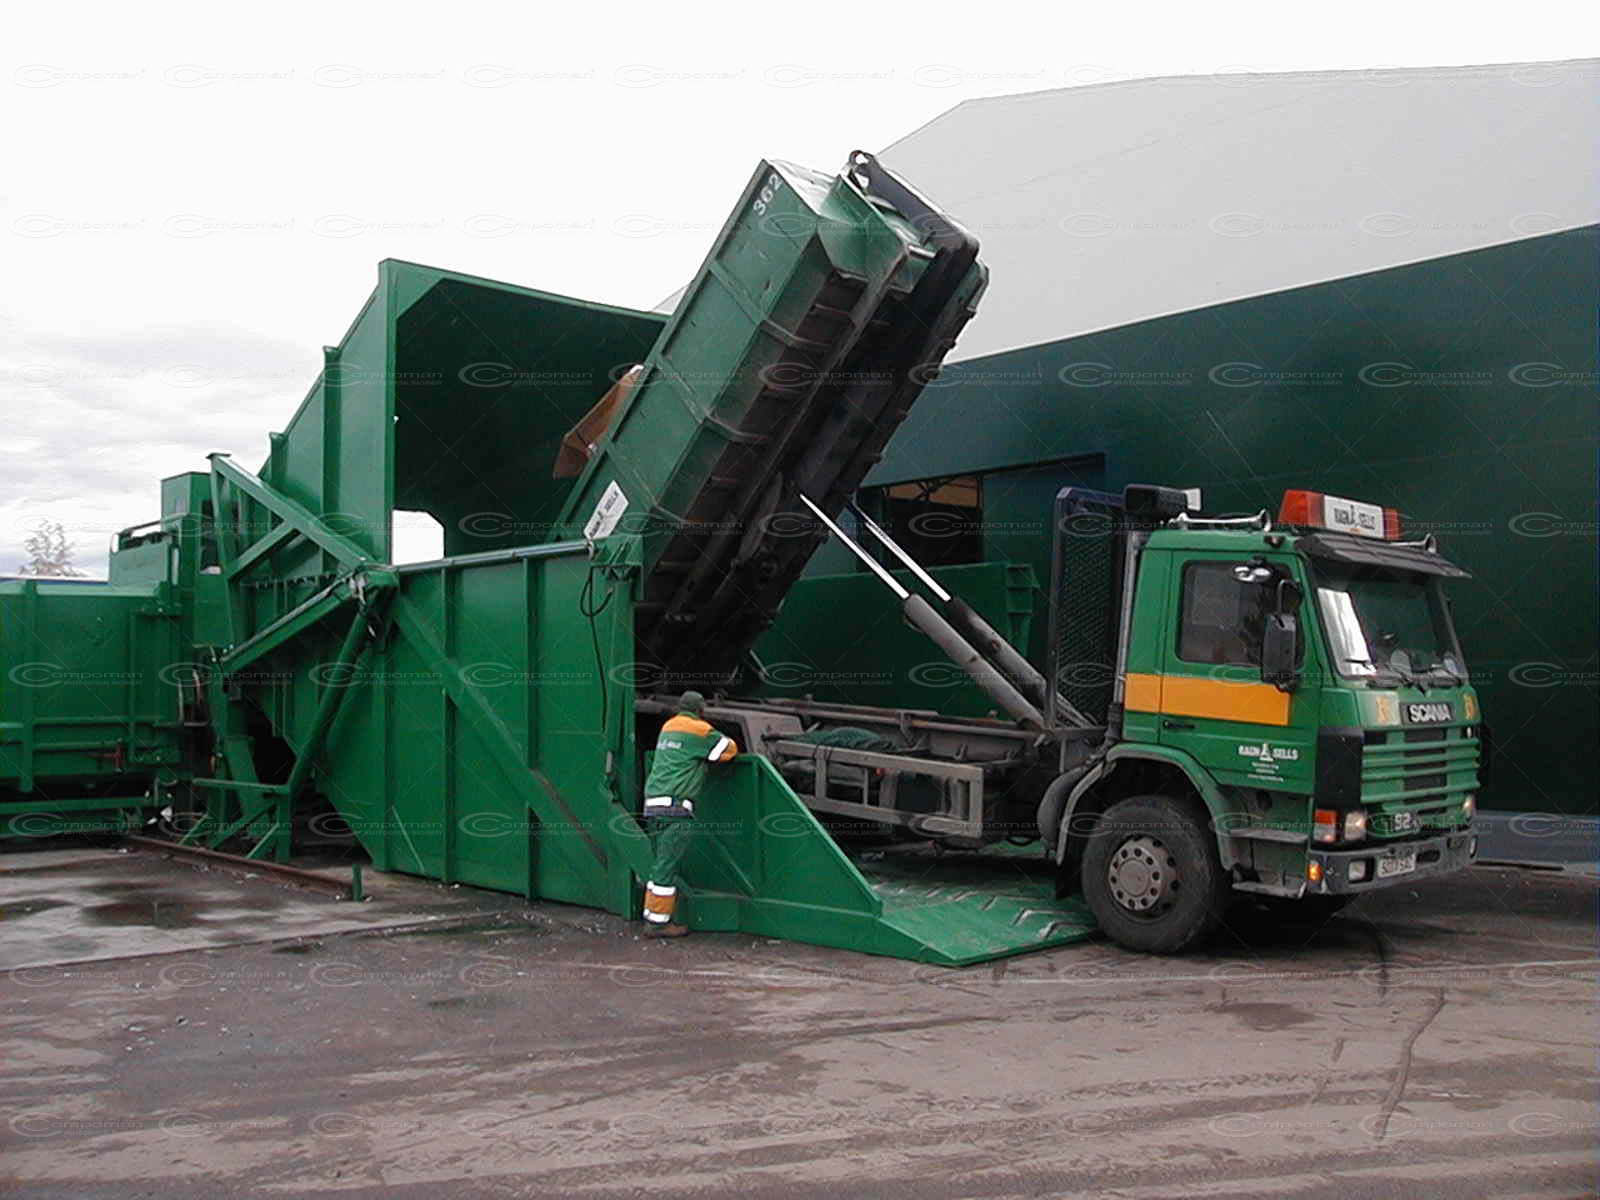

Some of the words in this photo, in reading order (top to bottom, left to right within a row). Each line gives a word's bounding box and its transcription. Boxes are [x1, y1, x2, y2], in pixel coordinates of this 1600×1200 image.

[753, 174, 783, 216] 362
[1409, 703, 1453, 723] SCANIA
[1394, 812, 1412, 831] 92
